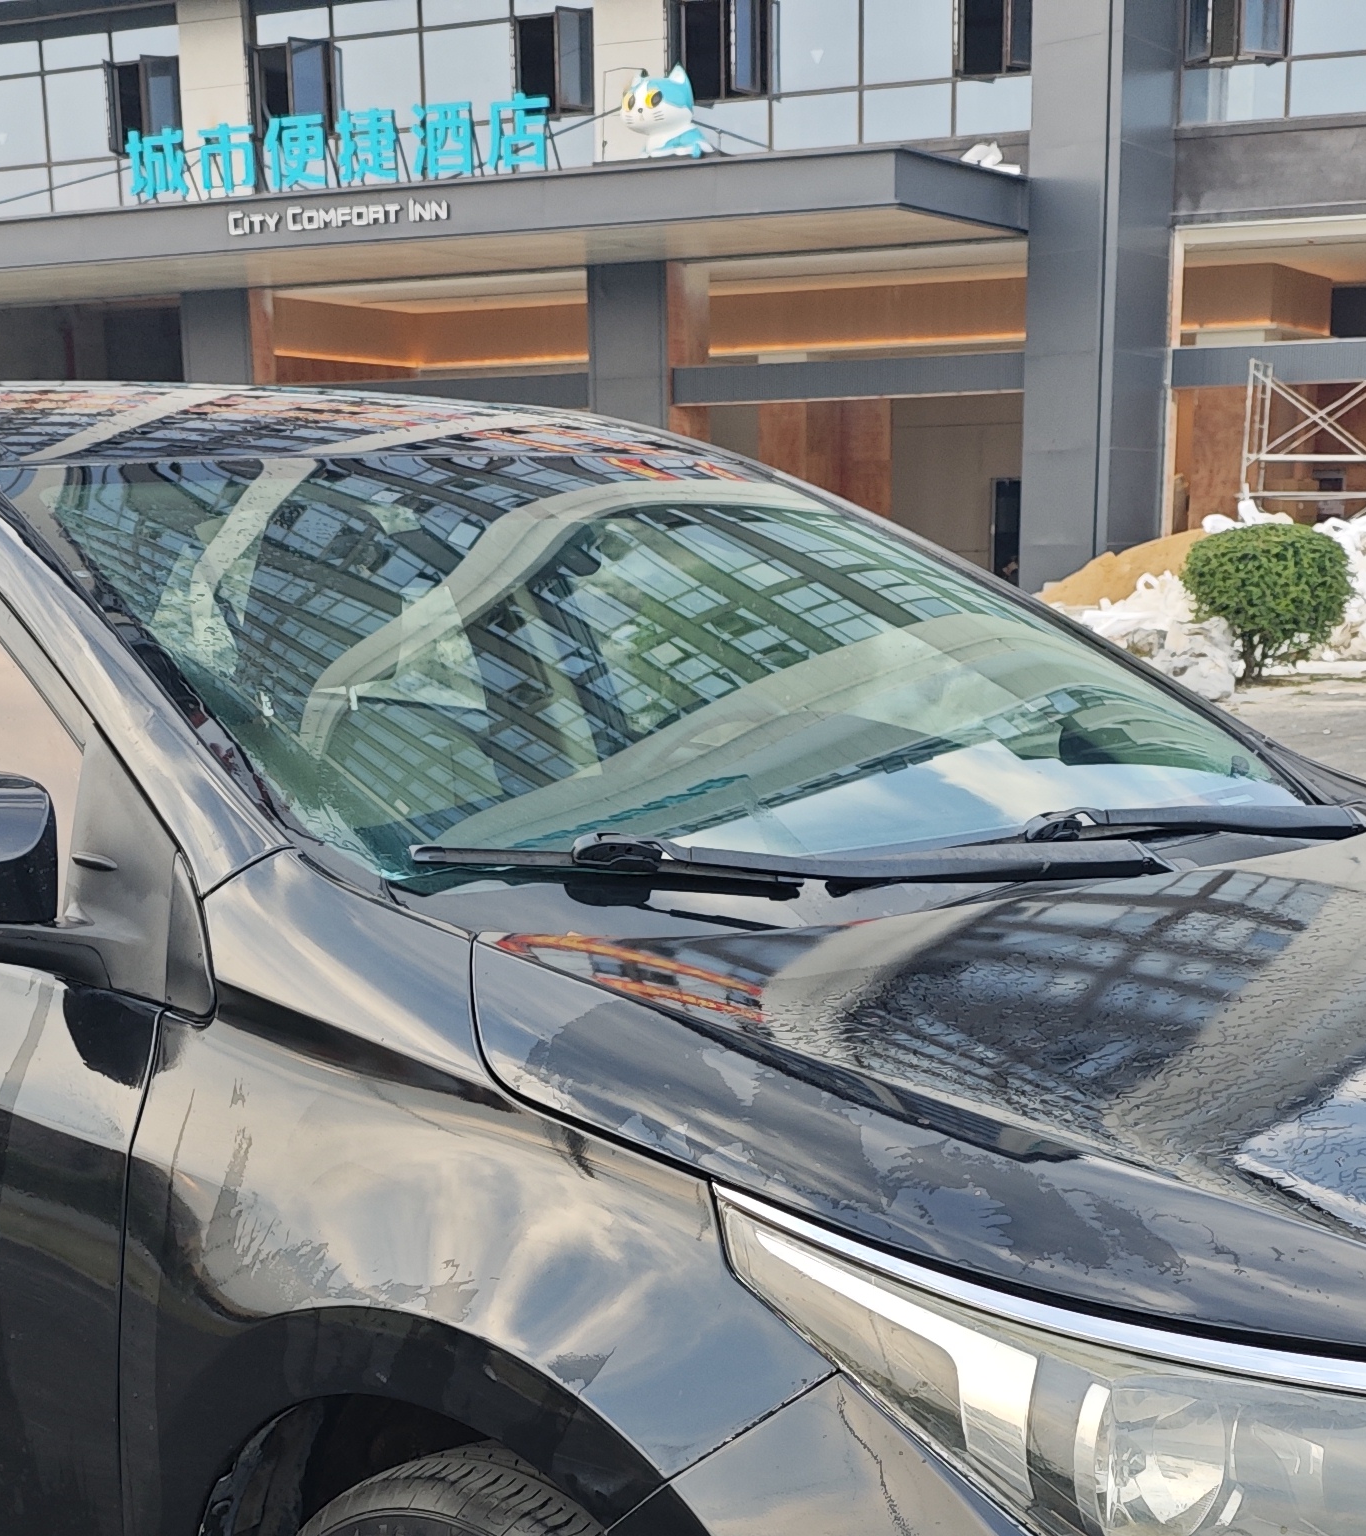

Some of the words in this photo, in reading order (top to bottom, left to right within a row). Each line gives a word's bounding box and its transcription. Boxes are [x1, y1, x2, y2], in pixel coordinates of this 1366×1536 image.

[125, 92, 551, 199] 城市便捷酒店
